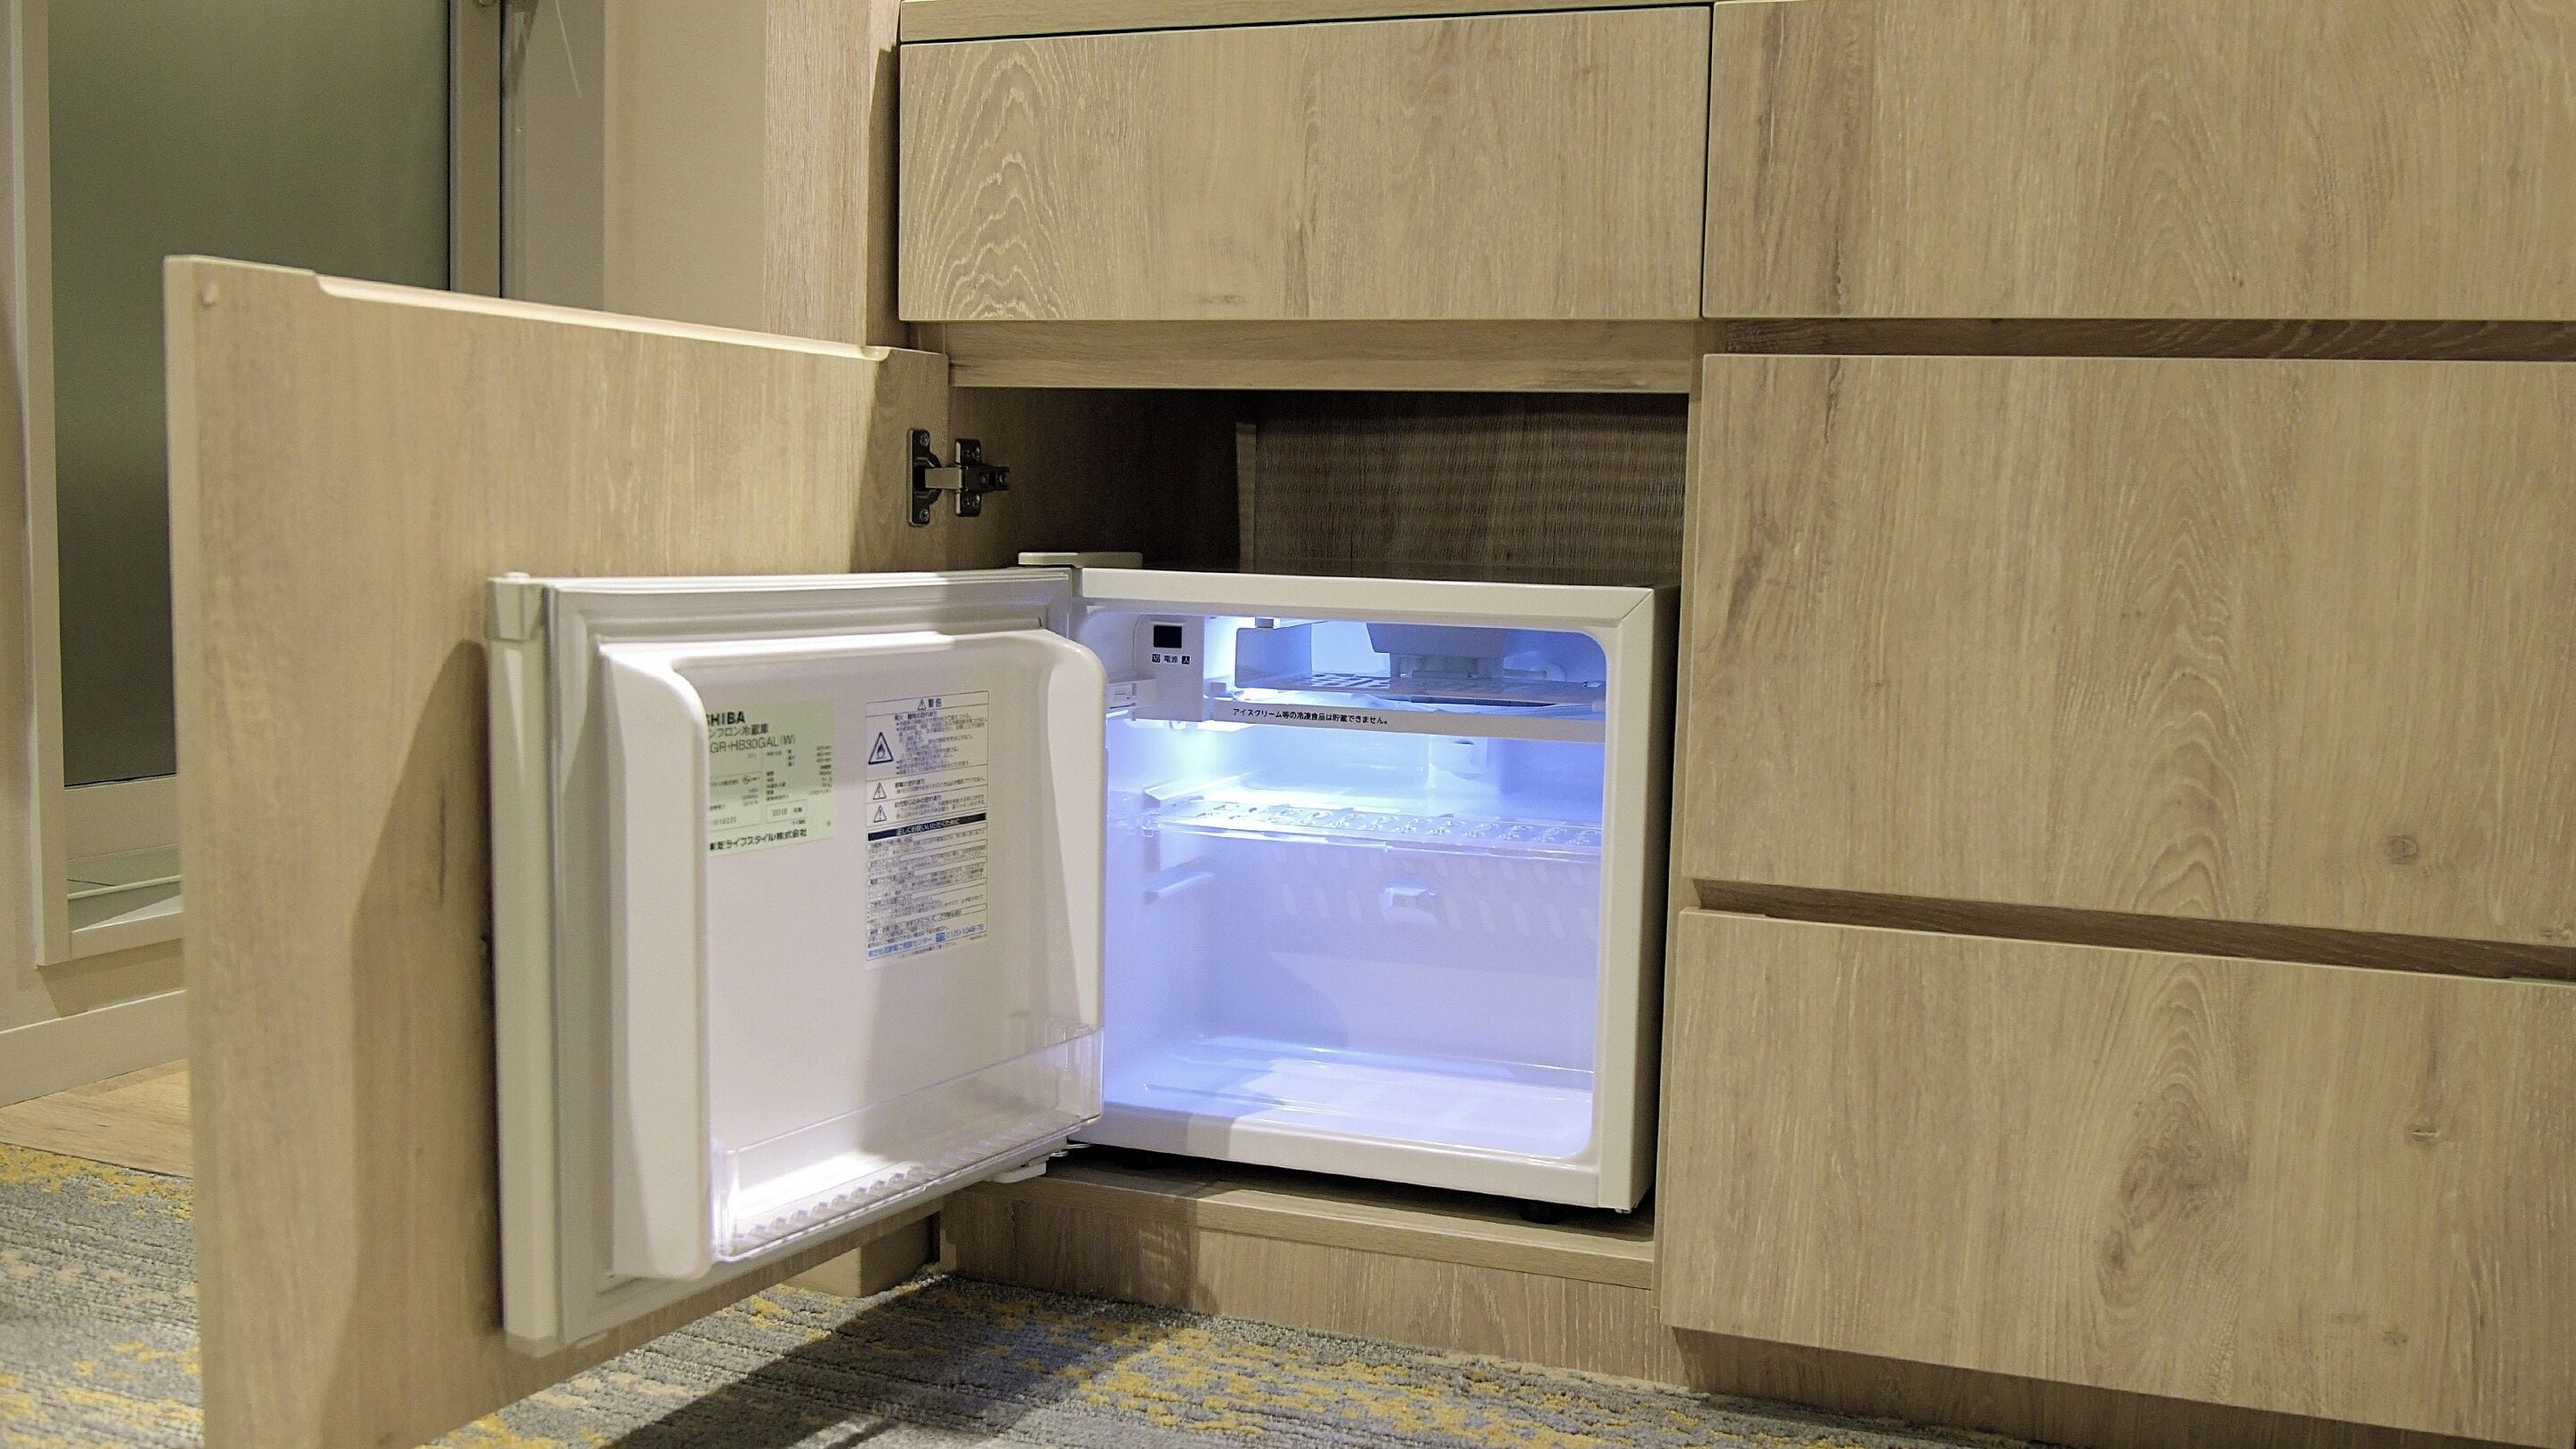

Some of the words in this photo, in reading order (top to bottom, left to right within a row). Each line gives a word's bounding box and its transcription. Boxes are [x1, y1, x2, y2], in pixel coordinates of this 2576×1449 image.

[1164, 655, 1179, 664] 電源
[1233, 708, 1388, 724] アイスクリーム等の冷凍食品は貯蔵できません。
